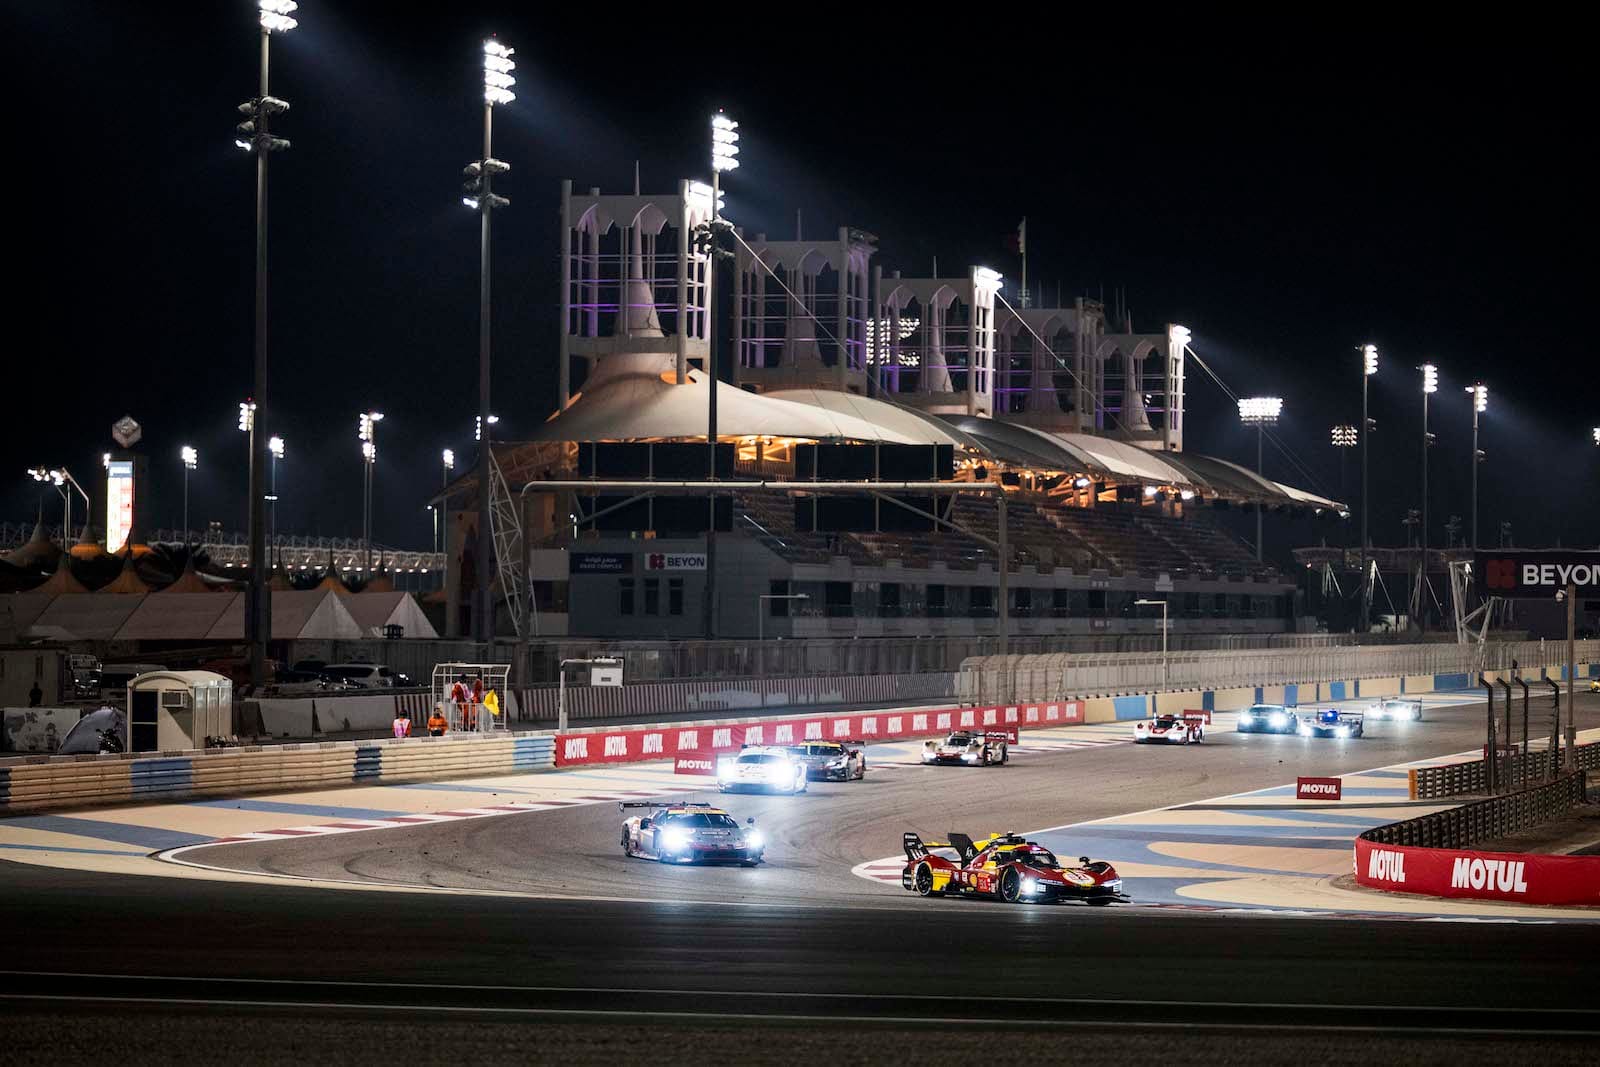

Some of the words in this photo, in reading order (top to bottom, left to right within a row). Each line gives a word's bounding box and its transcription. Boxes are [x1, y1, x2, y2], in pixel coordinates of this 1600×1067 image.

[667, 556, 705, 567] BEYON
[642, 733, 663, 754] MOTUL
[677, 730, 698, 750] MOTUL
[712, 727, 732, 748] MOTUL
[744, 725, 763, 745] MOTUL
[564, 737, 588, 760] MOTUL
[604, 735, 627, 757] MOTUL
[678, 760, 713, 770] MOTUL
[1300, 783, 1338, 794] MOTUL
[1368, 849, 1405, 883] MOTUL
[1451, 857, 1527, 893] MOTUL
